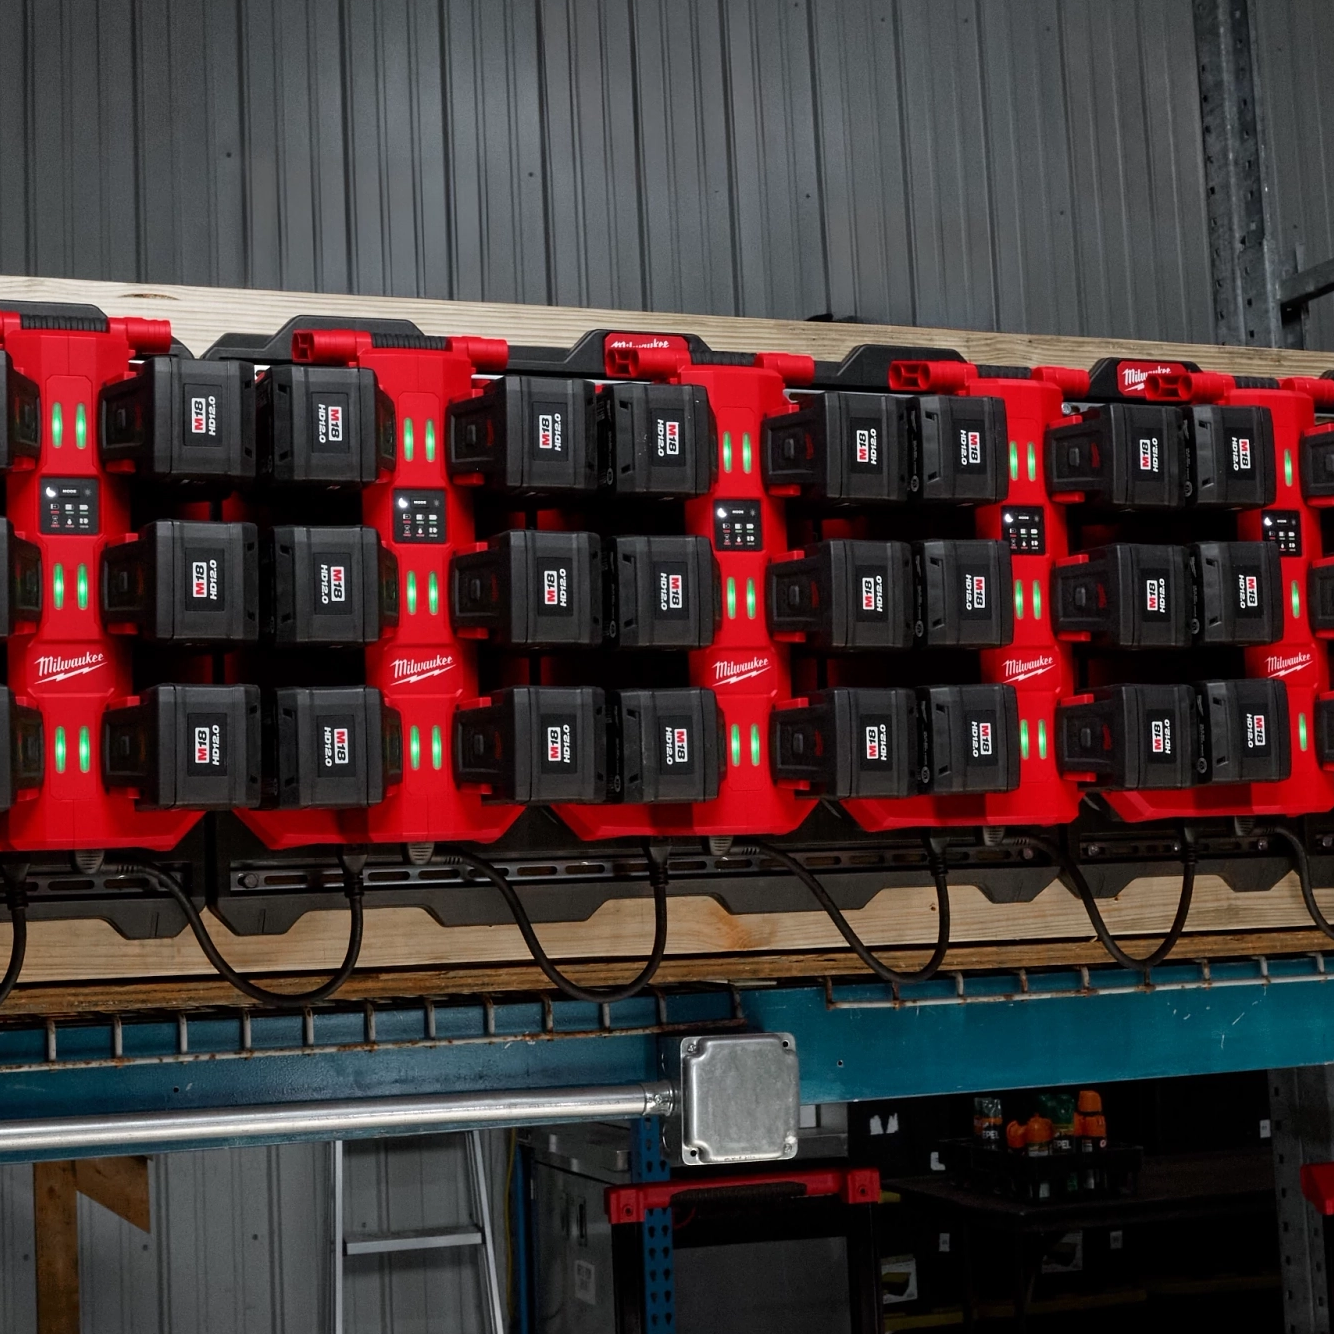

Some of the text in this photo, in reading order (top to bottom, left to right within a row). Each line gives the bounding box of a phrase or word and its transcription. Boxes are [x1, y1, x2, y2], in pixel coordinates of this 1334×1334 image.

[1122, 366, 1172, 385] Milwkee
[192, 399, 205, 432] M18
[207, 395, 217, 436] HD12.0
[317, 403, 327, 444] HD12.0
[329, 407, 341, 440] M18
[540, 416, 551, 448] M18
[553, 412, 562, 452] HD12.0
[656, 418, 665, 457] HD12.0
[667, 423, 678, 453] M18
[858, 431, 868, 461] M18
[869, 428, 877, 465] HD12.0
[969, 433, 979, 462] M18
[1141, 440, 1150, 469] M18
[1240, 440, 1249, 467] M18
[194, 563, 206, 596] M18
[209, 559, 218, 601] HD12.0
[320, 564, 329, 605] HD12.0
[331, 567, 344, 600] M18
[545, 572, 557, 603] M18
[559, 568, 567, 607] HD12.0
[660, 572, 668, 611] HD12.0
[670, 576, 681, 607] M18
[863, 579, 873, 609] M18
[875, 575, 883, 613] HD12.0
[975, 578, 984, 607] M18
[1148, 581, 1157, 609] M18
[1247, 578, 1257, 605] M18
[34, 651, 104, 677] Milwaukee
[389, 655, 453, 679] Milwaukee
[712, 657, 769, 679] Milwaukee
[1001, 655, 1053, 677] Milwaukee
[1264, 652, 1311, 673] Milwaukee
[196, 728, 208, 762] M18
[211, 724, 220, 766] HD12.0
[335, 729, 347, 763] M18
[549, 728, 560, 760] M18
[562, 724, 571, 764] HD12.0
[665, 726, 674, 766] HD12.0
[675, 730, 687, 761] M18
[867, 728, 877, 758] M18
[879, 723, 888, 761] HD12.0
[981, 724, 991, 753] M18
[1153, 722, 1162, 751] M18
[1255, 716, 1264, 744] M18
[323, 726, 333, 767] HD12.0
